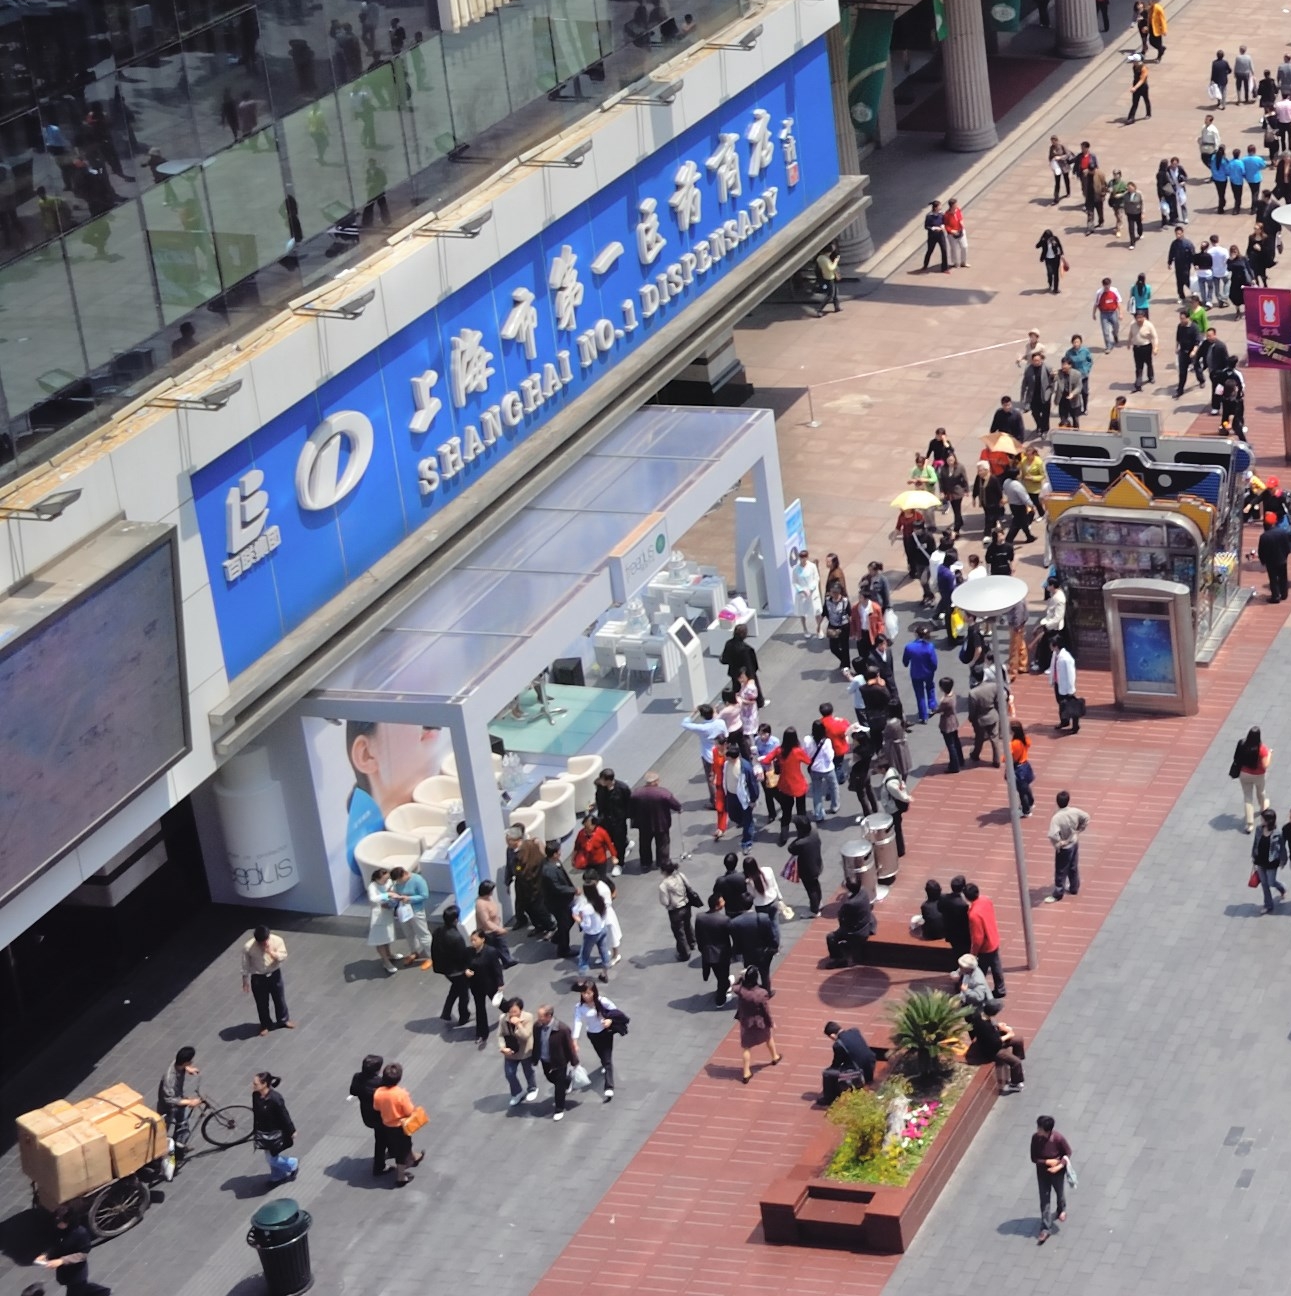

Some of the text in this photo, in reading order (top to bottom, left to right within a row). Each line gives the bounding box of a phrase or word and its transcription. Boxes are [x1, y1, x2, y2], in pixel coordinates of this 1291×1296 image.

[409, 108, 775, 433] 上海市第一医药商店
[418, 187, 779, 495] SHANGHAI NO.1 DISPENSARY
